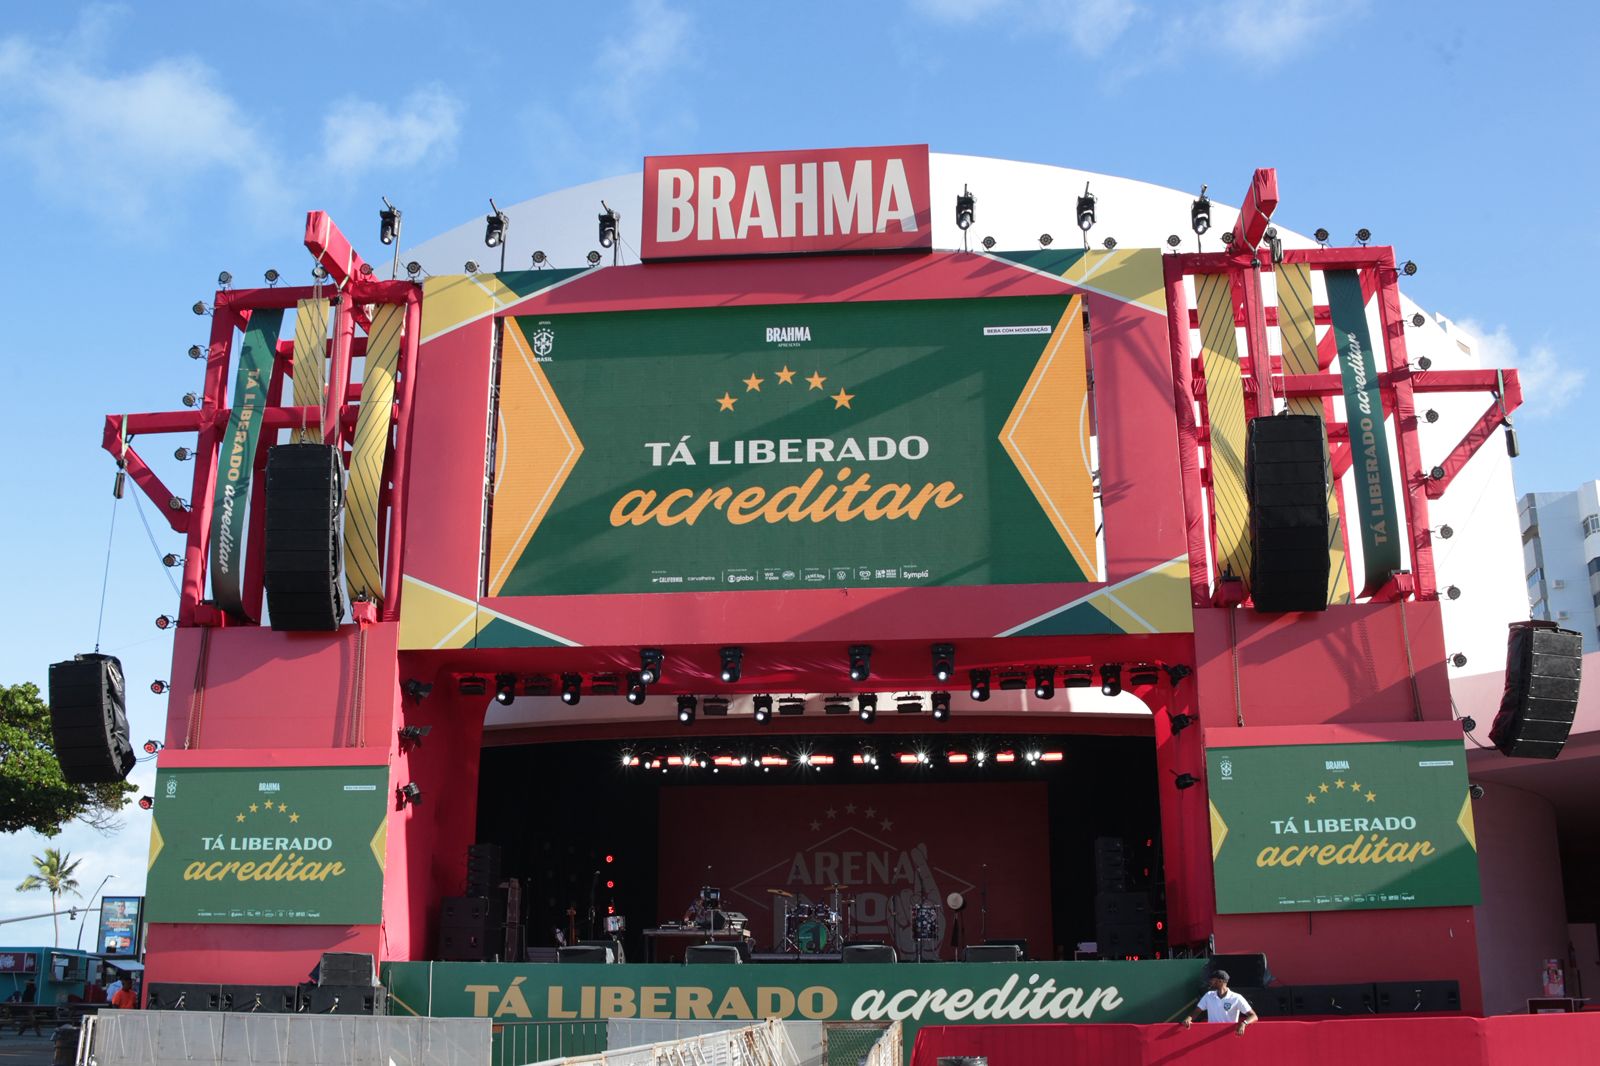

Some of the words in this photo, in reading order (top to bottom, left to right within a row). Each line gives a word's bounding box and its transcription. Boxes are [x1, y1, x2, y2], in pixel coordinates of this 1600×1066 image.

[656, 158, 919, 242] BRAHMA
[766, 326, 812, 343] BRAHMA
[246, 368, 261, 390] TÁ
[1348, 332, 1372, 415] acreditar
[227, 391, 255, 482] LIBERADO
[644, 436, 696, 467] TÁ
[708, 435, 929, 466] LIBERADO
[1360, 417, 1386, 516] LIBERADO
[609, 467, 963, 528] acreditar
[220, 484, 236, 574] acreditar
[1369, 519, 1388, 546] TÁ
[736, 575, 754, 583] globo
[1325, 760, 1350, 770] BRAHMA
[258, 782, 281, 792] BRAHMA
[1270, 816, 1299, 835] TÁ
[1304, 816, 1417, 833] LIBERADO
[202, 834, 225, 851] TÁ
[230, 837, 333, 851] LIBERADO
[1256, 833, 1435, 867] acreditar
[183, 852, 346, 882] acreditar
[786, 851, 915, 885] ARENA
[464, 976, 534, 1020] TÁ
[547, 985, 838, 1020] LIBERADO
[850, 973, 1124, 1021] acreditar
